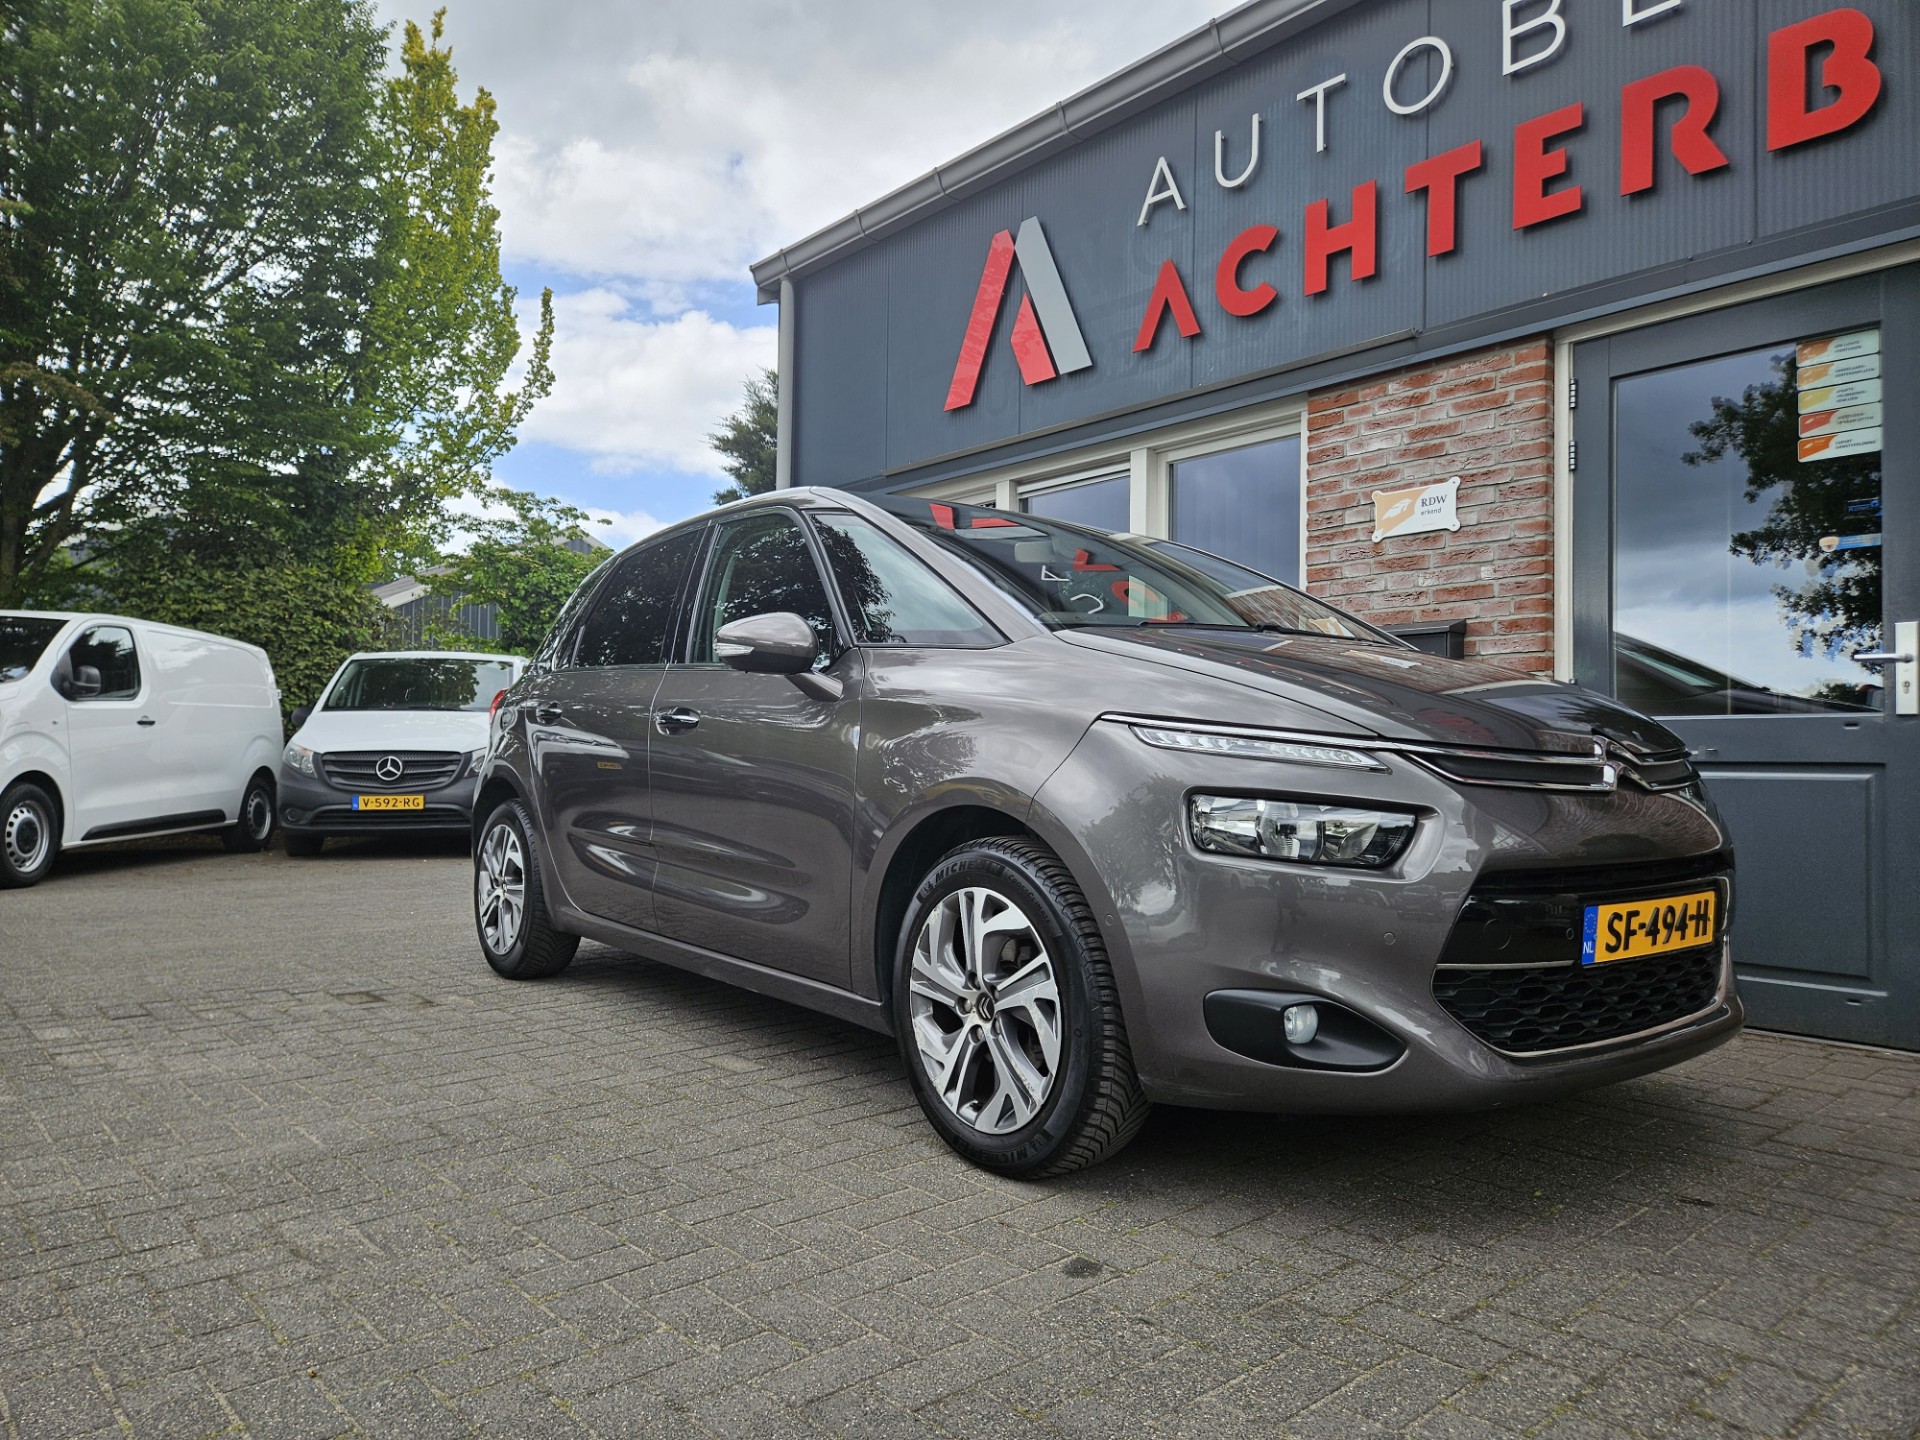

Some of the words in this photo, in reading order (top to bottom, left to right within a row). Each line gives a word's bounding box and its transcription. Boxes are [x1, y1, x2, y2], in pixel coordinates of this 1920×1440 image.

[1132, 8, 1882, 353] ACHTERB
[1421, 494, 1448, 508] RDW
[1420, 507, 1442, 516] erkend
[362, 797, 421, 808] V-592-RG
[1605, 899, 1710, 953] SF-494-H
[1583, 941, 1594, 954] NL
